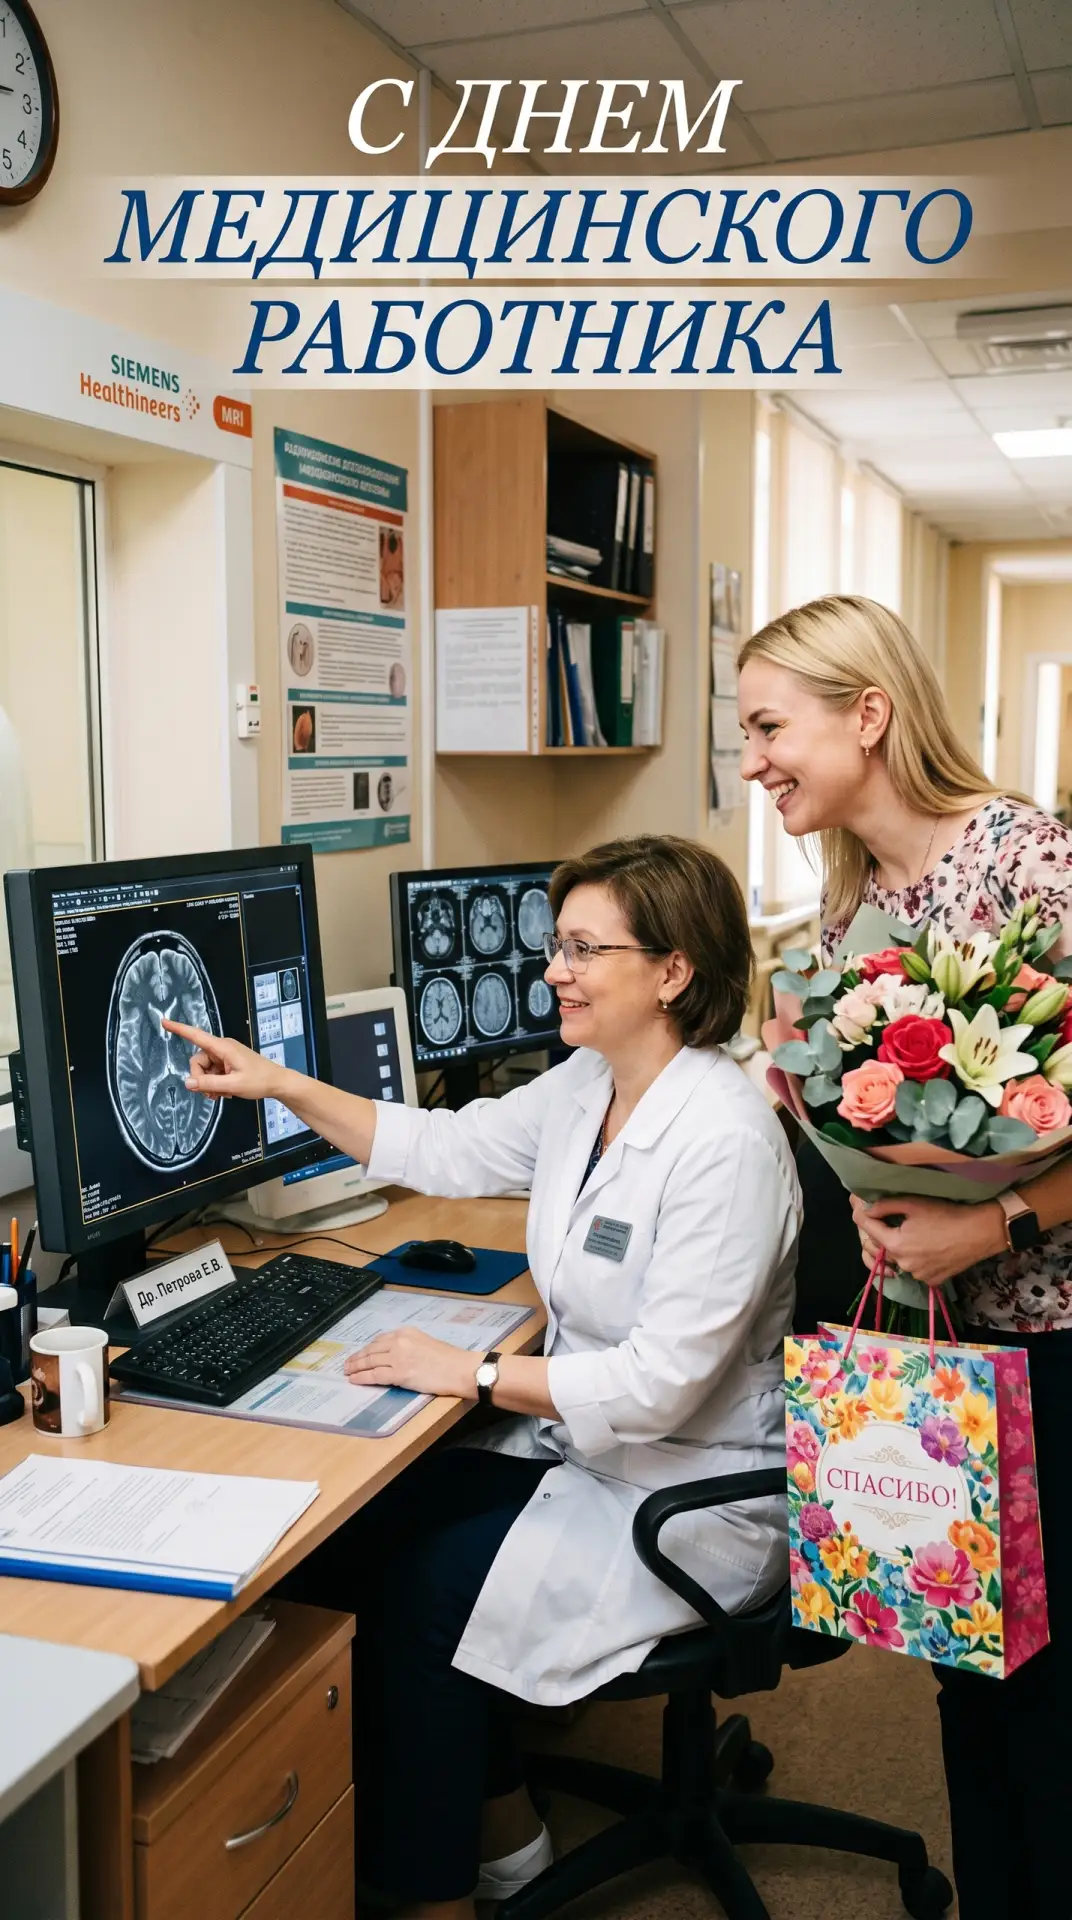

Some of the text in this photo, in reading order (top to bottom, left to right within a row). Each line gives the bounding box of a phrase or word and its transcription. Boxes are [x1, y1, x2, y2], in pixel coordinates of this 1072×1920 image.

[15, 52, 25, 76] 2
[22, 93, 32, 115] 3
[17, 130, 27, 149] 4
[2, 148, 12, 170] 5
[111, 354, 180, 393] SIEMENS
[80, 372, 181, 423] Healthineers
[221, 404, 244, 428] MRI
[137, 1258, 223, 1310] Др. Петрова Е.В.
[827, 1468, 957, 1509] СПАСИБО!
